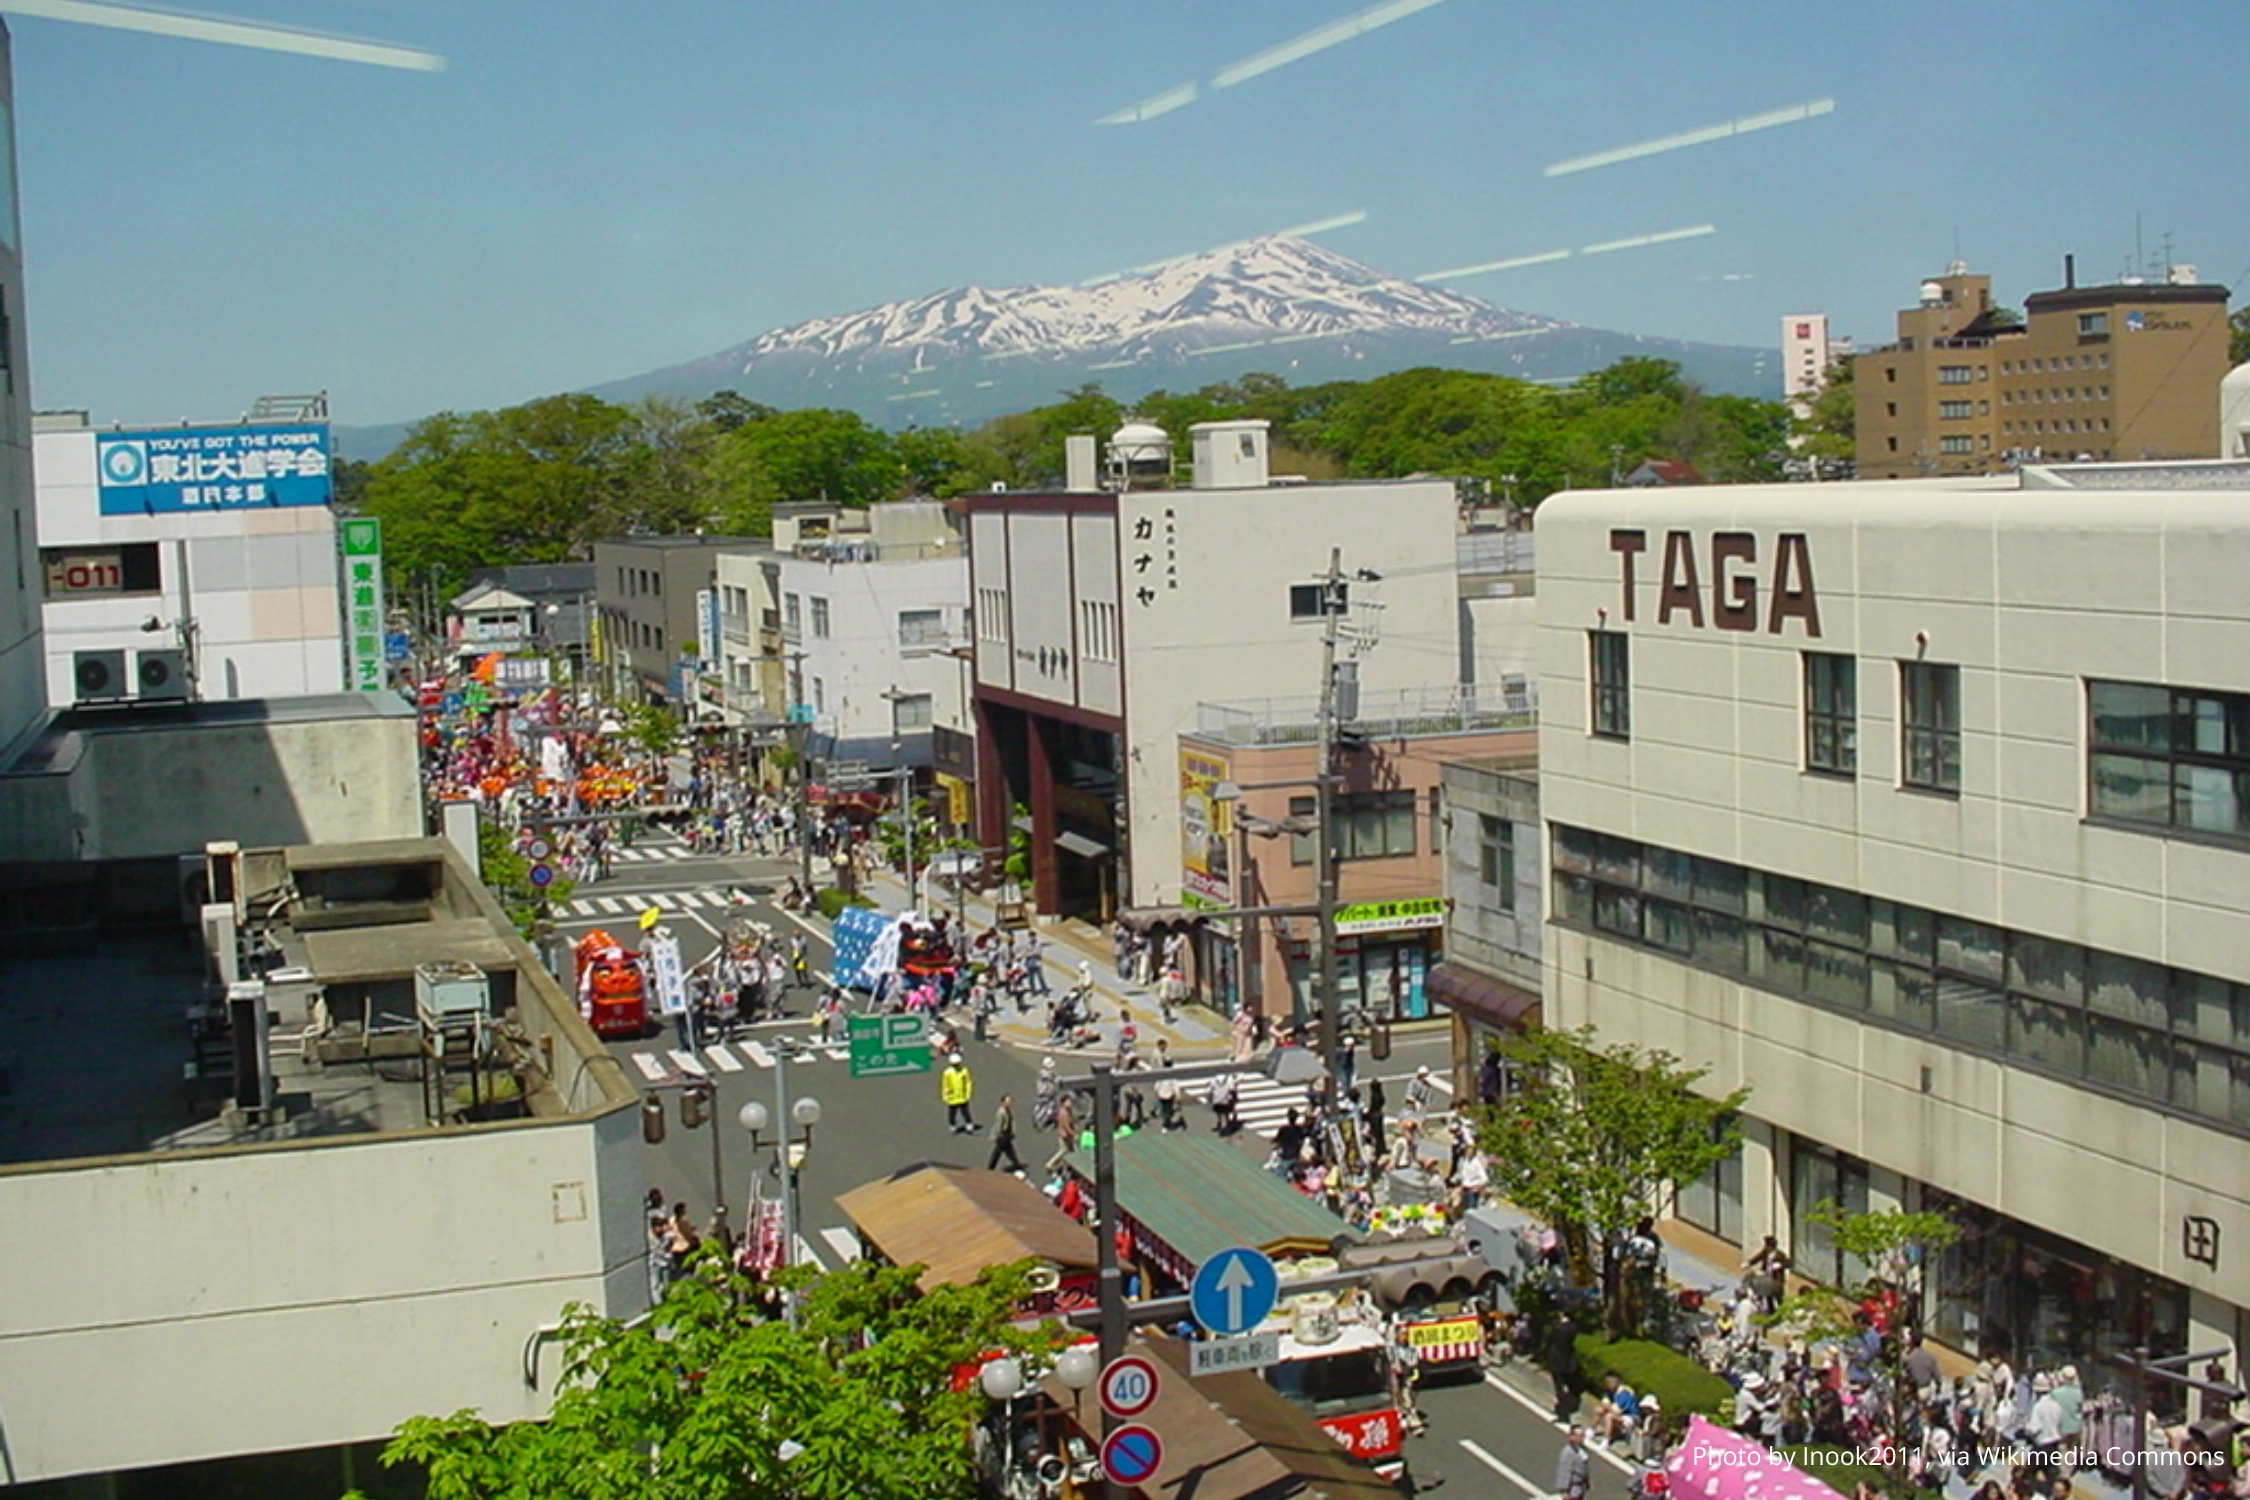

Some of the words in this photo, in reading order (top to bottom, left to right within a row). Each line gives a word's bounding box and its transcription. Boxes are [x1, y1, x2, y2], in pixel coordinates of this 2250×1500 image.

[151, 438, 199, 451] YOU'VE
[204, 436, 233, 448] GOT
[239, 435, 268, 447] THE
[271, 433, 319, 446] POWER
[151, 448, 326, 483] 東北大進学会
[1134, 517, 1155, 608] カナヤ
[1610, 529, 1821, 638] TAGA
[887, 1018, 922, 1045] P
[2183, 1215, 2220, 1273] 田
[1113, 1373, 1146, 1399] 40
